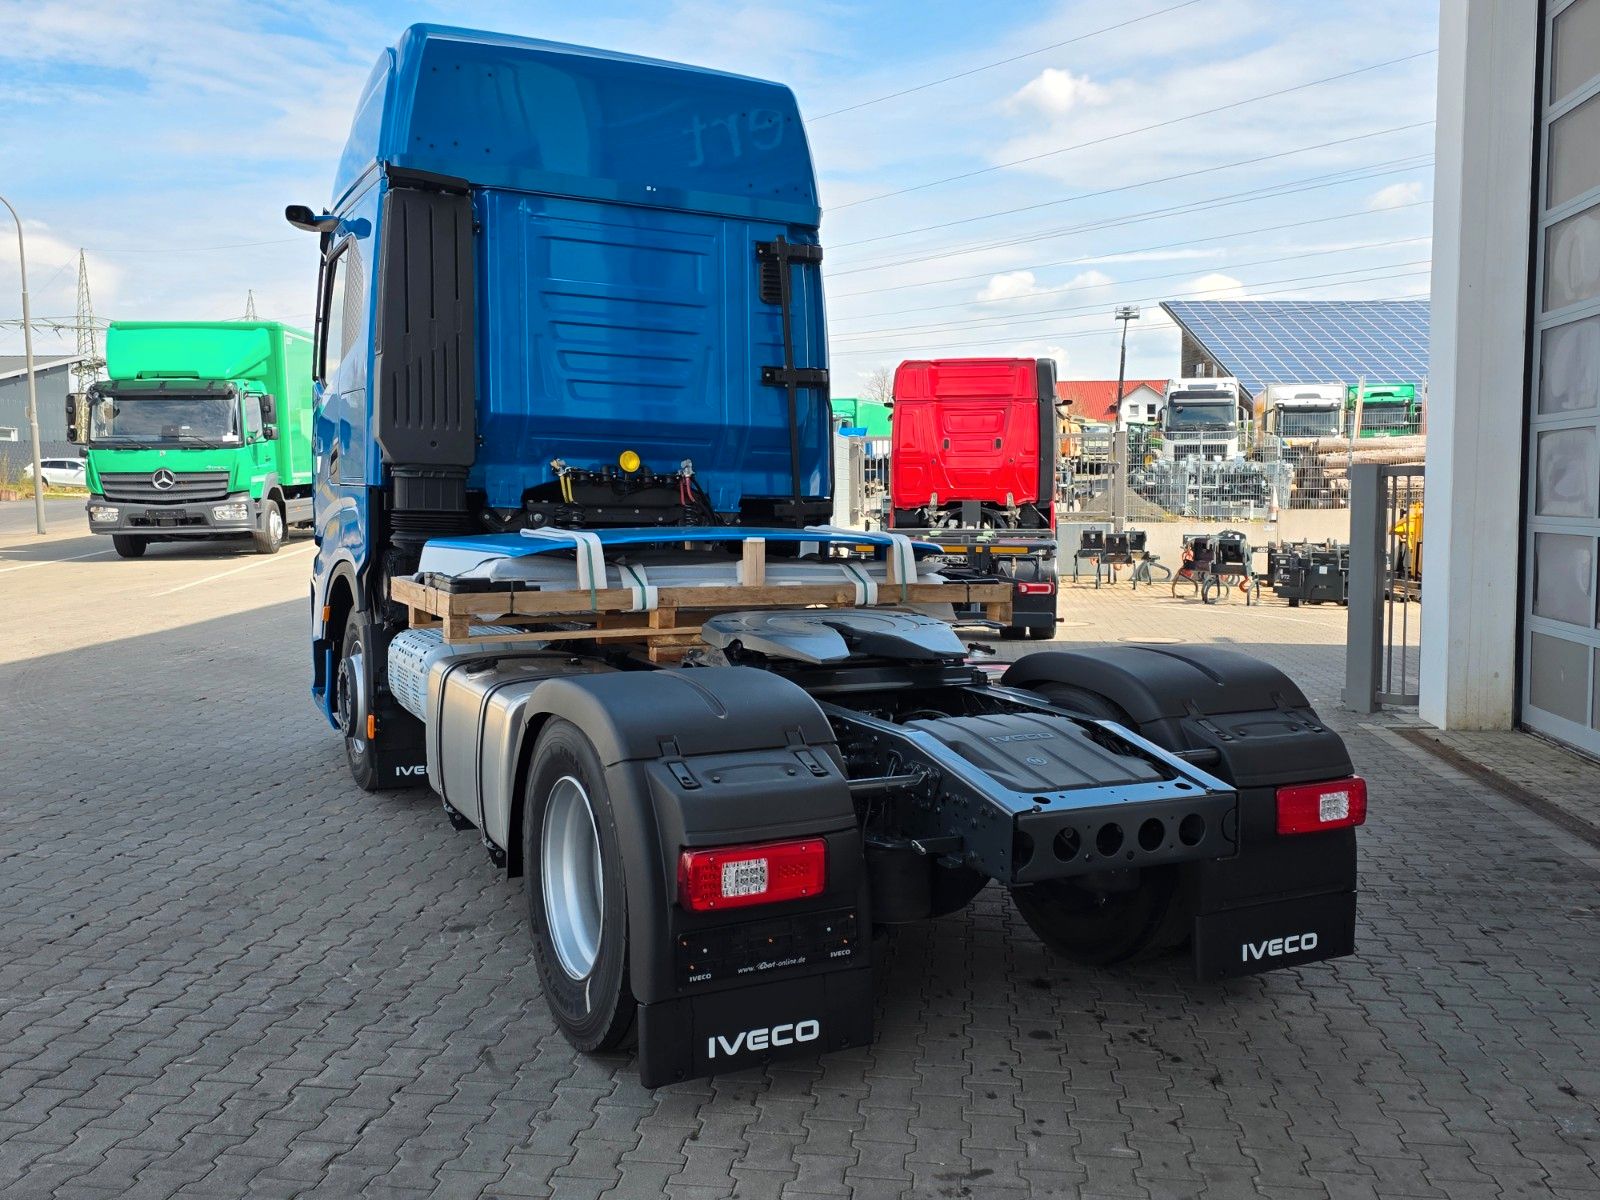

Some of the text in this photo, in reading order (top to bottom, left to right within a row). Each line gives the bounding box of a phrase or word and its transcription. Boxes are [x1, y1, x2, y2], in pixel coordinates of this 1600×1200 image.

[990, 732, 1054, 743] IVECO
[395, 765, 428, 776] IVE
[1242, 932, 1318, 962] IVECO
[830, 949, 851, 958] IVECO
[689, 973, 712, 983] IVECO
[708, 1019, 820, 1059] IVECO
